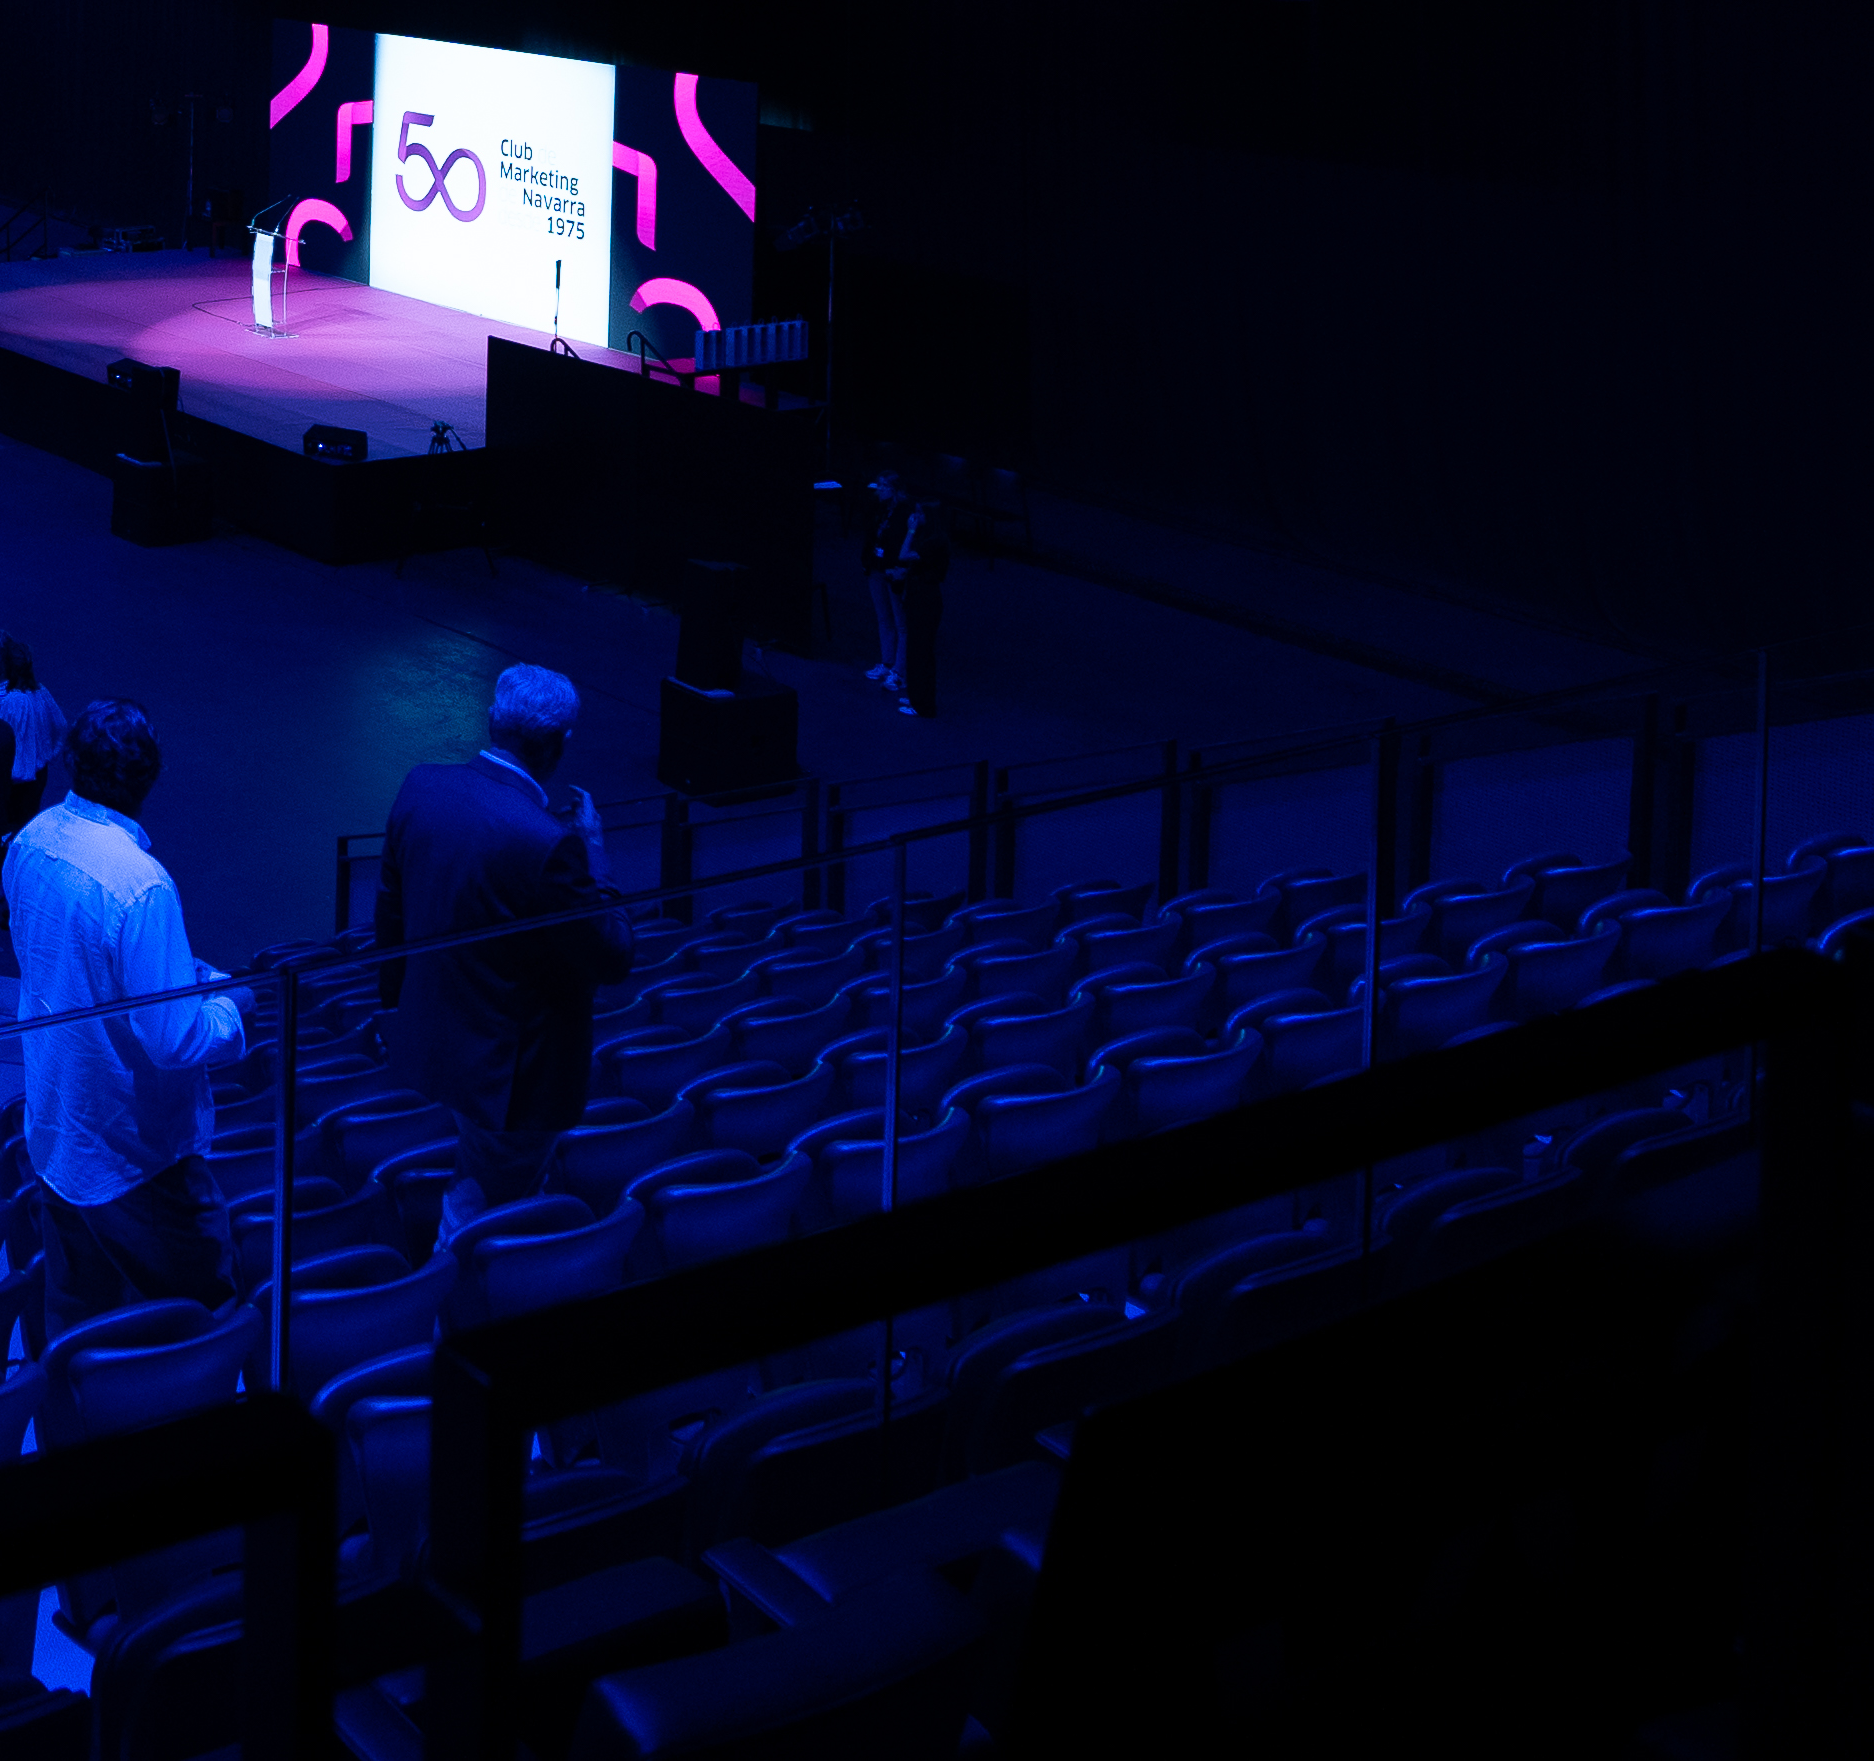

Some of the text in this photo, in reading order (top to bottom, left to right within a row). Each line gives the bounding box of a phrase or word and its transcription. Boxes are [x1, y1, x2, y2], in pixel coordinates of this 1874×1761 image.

[395, 110, 487, 223] 50
[500, 138, 556, 166] Club de
[499, 161, 580, 196] Marketing
[522, 188, 586, 217] Navarra
[547, 216, 586, 240] 1975
